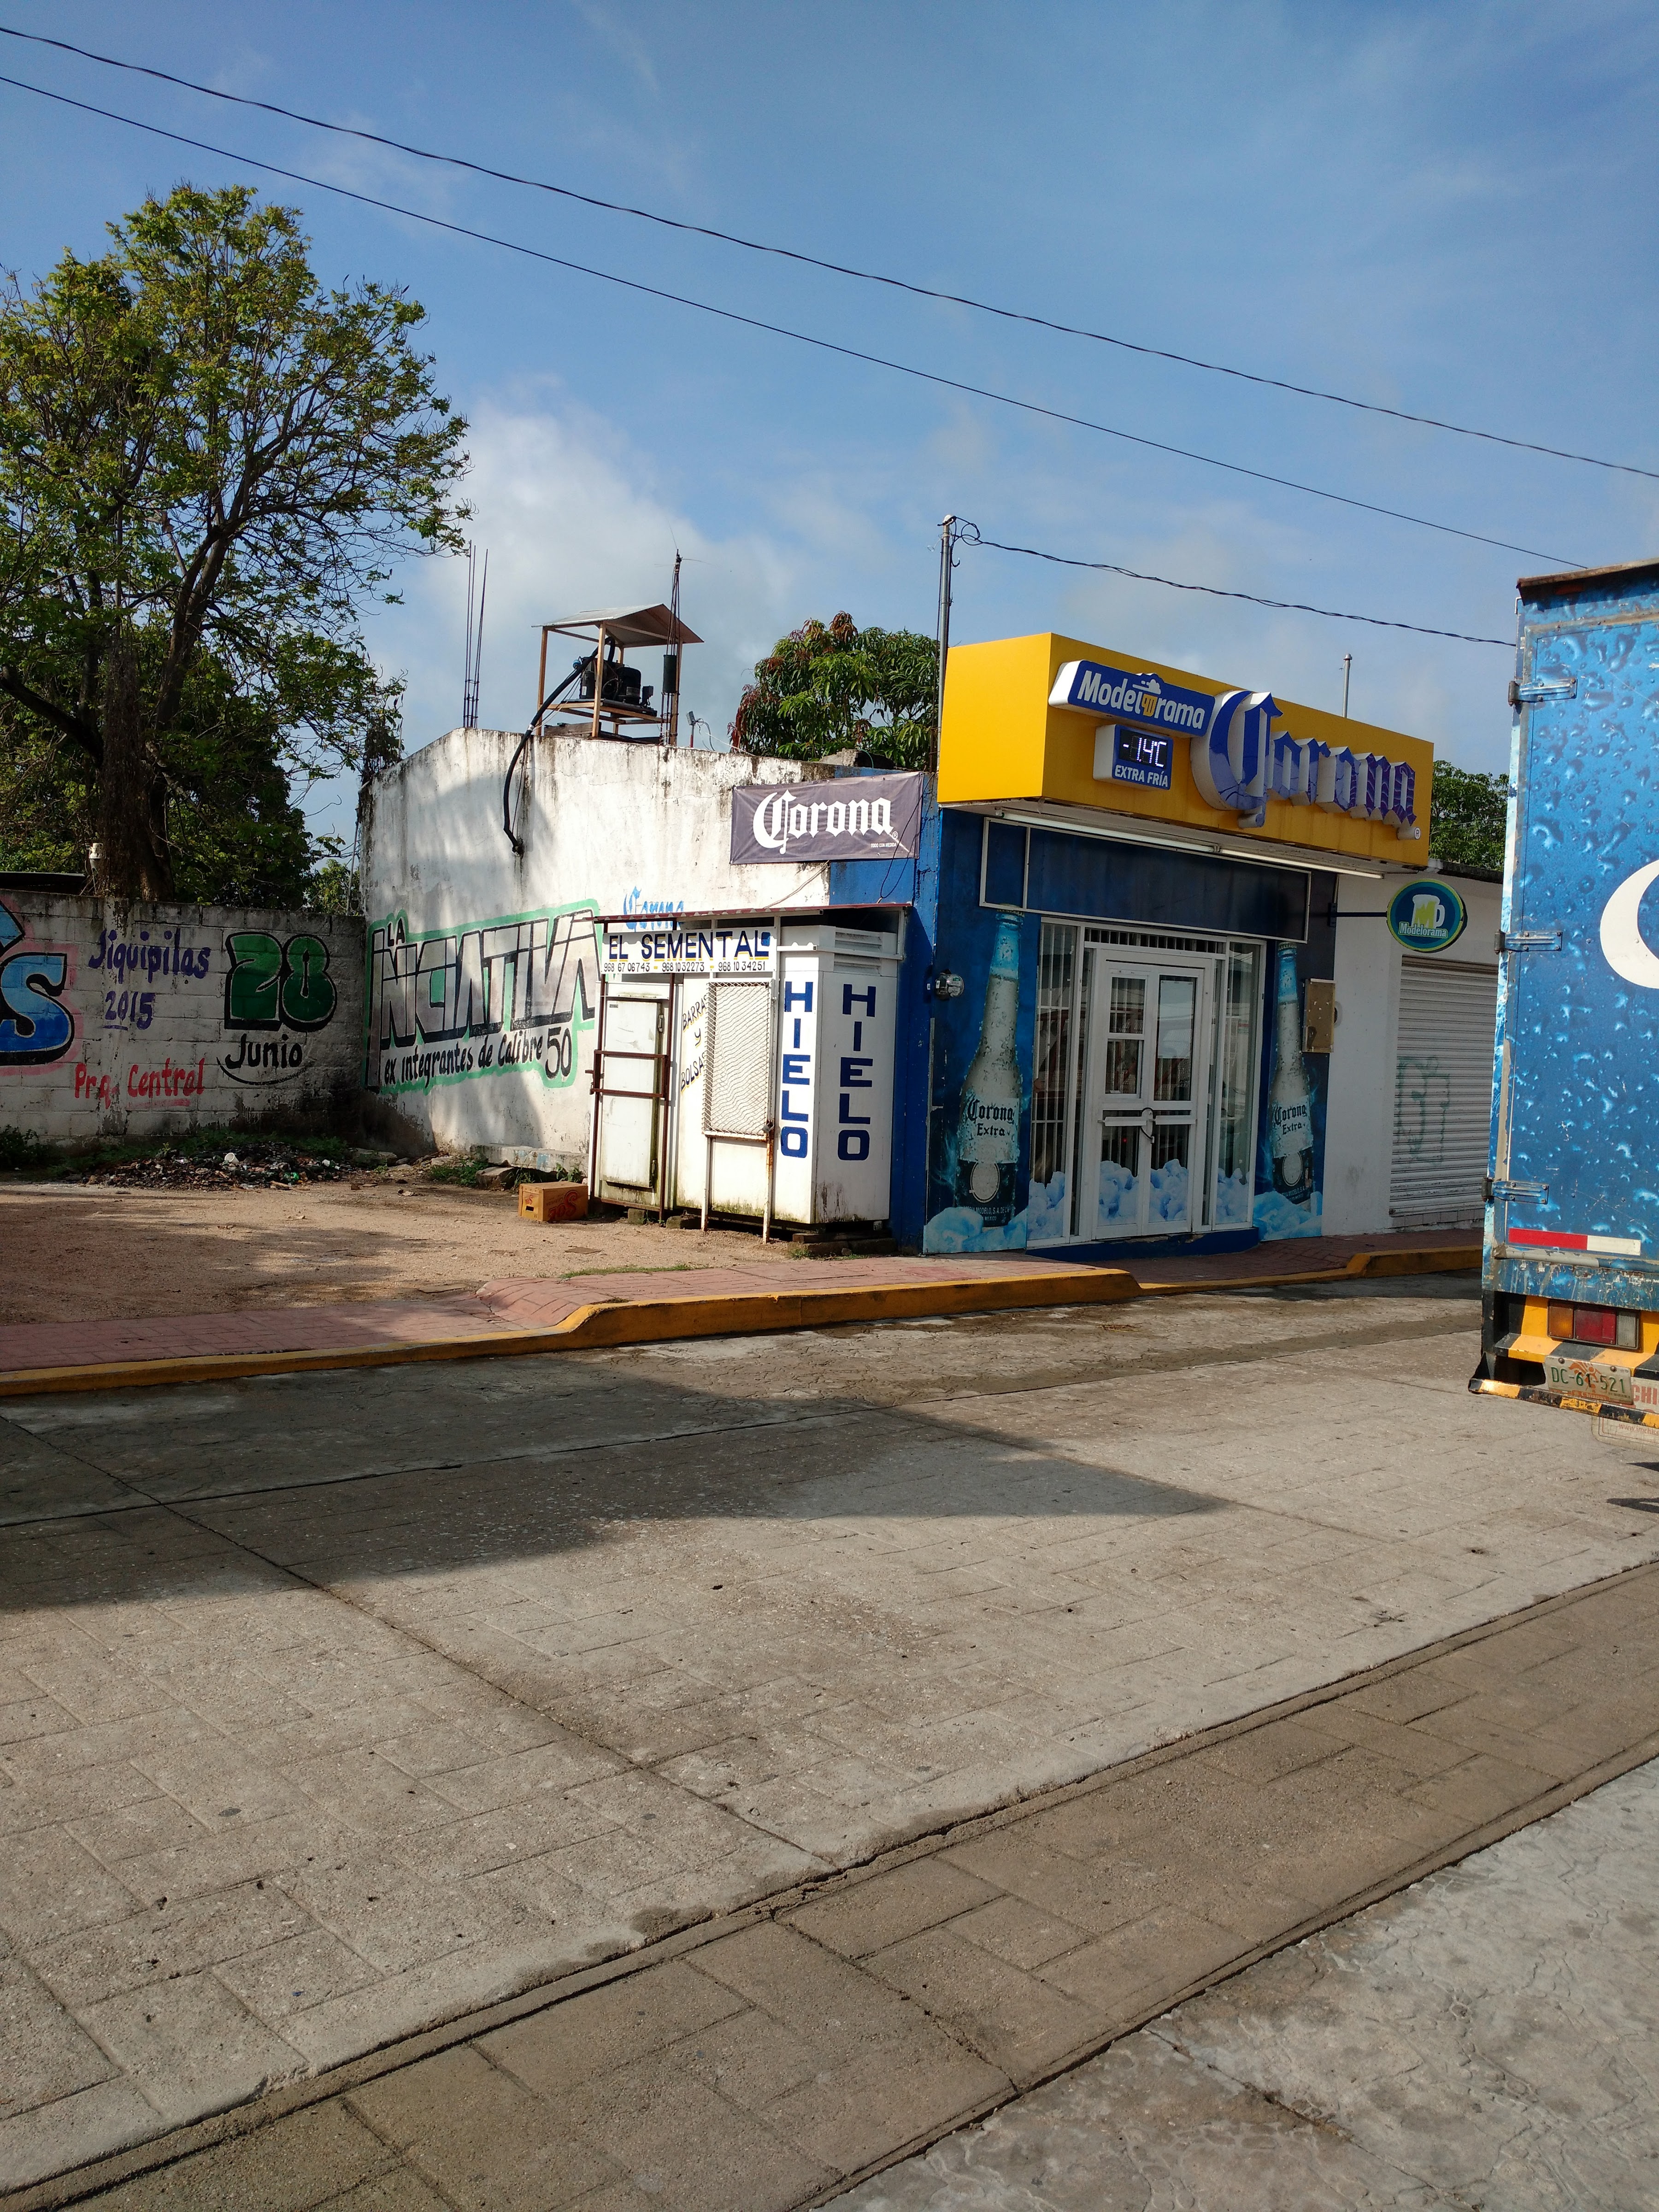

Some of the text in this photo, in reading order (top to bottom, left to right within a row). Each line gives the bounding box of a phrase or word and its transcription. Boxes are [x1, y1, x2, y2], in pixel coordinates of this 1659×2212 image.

[1194, 690, 1417, 828] Corona
[1114, 764, 1168, 788] EXTRA FRÍA
[753, 789, 894, 854] Corona
[387, 918, 406, 947] LA
[609, 930, 770, 961] EL SEMENTAL
[1400, 923, 1447, 937] Modelorama
[88, 928, 212, 984] Jiquipilas
[604, 963, 615, 972] 968
[618, 963, 625, 972] 67
[627, 962, 650, 972] 06743
[662, 962, 674, 972] 968
[718, 961, 731, 971] 968
[741, 961, 766, 971] 34251
[224, 931, 337, 1033] 28
[104, 990, 156, 1030] 2015
[225, 1033, 303, 1069] Junio
[384, 1055, 396, 1086] ex
[477, 1034, 494, 1068] de
[498, 1030, 543, 1067] Calibre
[545, 1026, 572, 1079] 50
[127, 1057, 206, 1098] Central
[781, 981, 813, 1159] HIELO
[837, 983, 877, 1161] HIELO
[967, 1098, 1014, 1124] Corona
[1274, 1104, 1307, 1126] Corona
[977, 1122, 1006, 1136] Extra
[1282, 1121, 1303, 1135] Extra
[1551, 1366, 1626, 1394] DC-61-521
